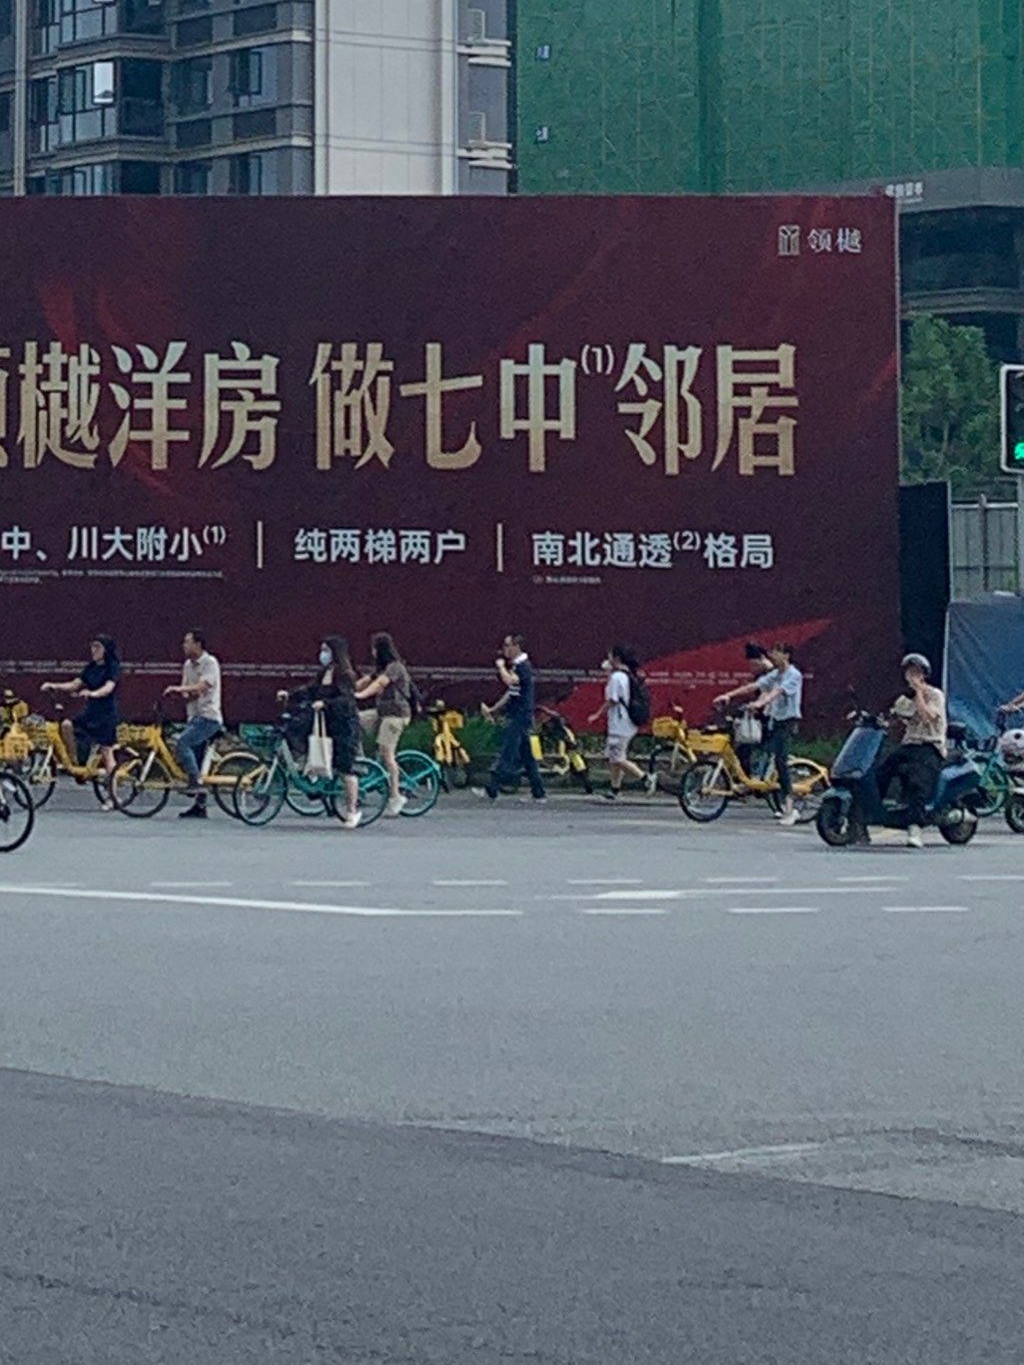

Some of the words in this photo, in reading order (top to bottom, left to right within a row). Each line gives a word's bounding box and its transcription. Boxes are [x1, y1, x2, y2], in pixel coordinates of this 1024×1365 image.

[294, 527, 466, 566] 纯两梯两户
